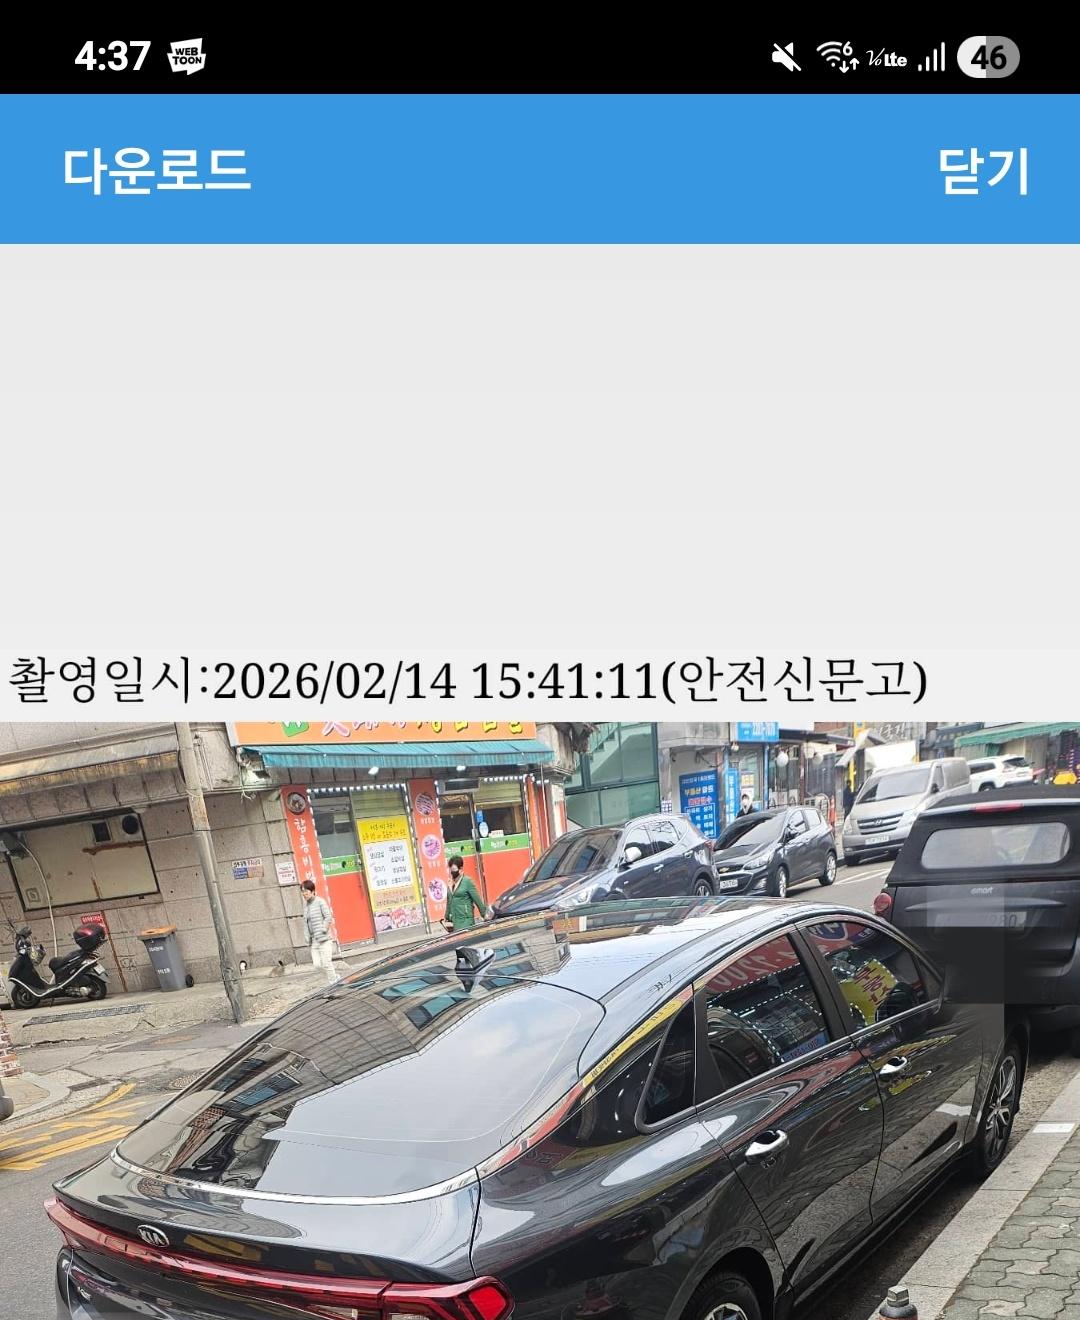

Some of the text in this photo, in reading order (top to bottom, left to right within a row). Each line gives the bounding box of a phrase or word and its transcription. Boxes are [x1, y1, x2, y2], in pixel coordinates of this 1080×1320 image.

[75, 40, 151, 71] 4:37
[172, 56, 202, 65] TOON
[175, 47, 198, 56] WEB
[971, 45, 1007, 70] 46
[64, 147, 252, 196] 다운로드
[940, 147, 1028, 196] 닫기
[970, 886, 994, 895] smart
[139, 1228, 167, 1247] KIA
